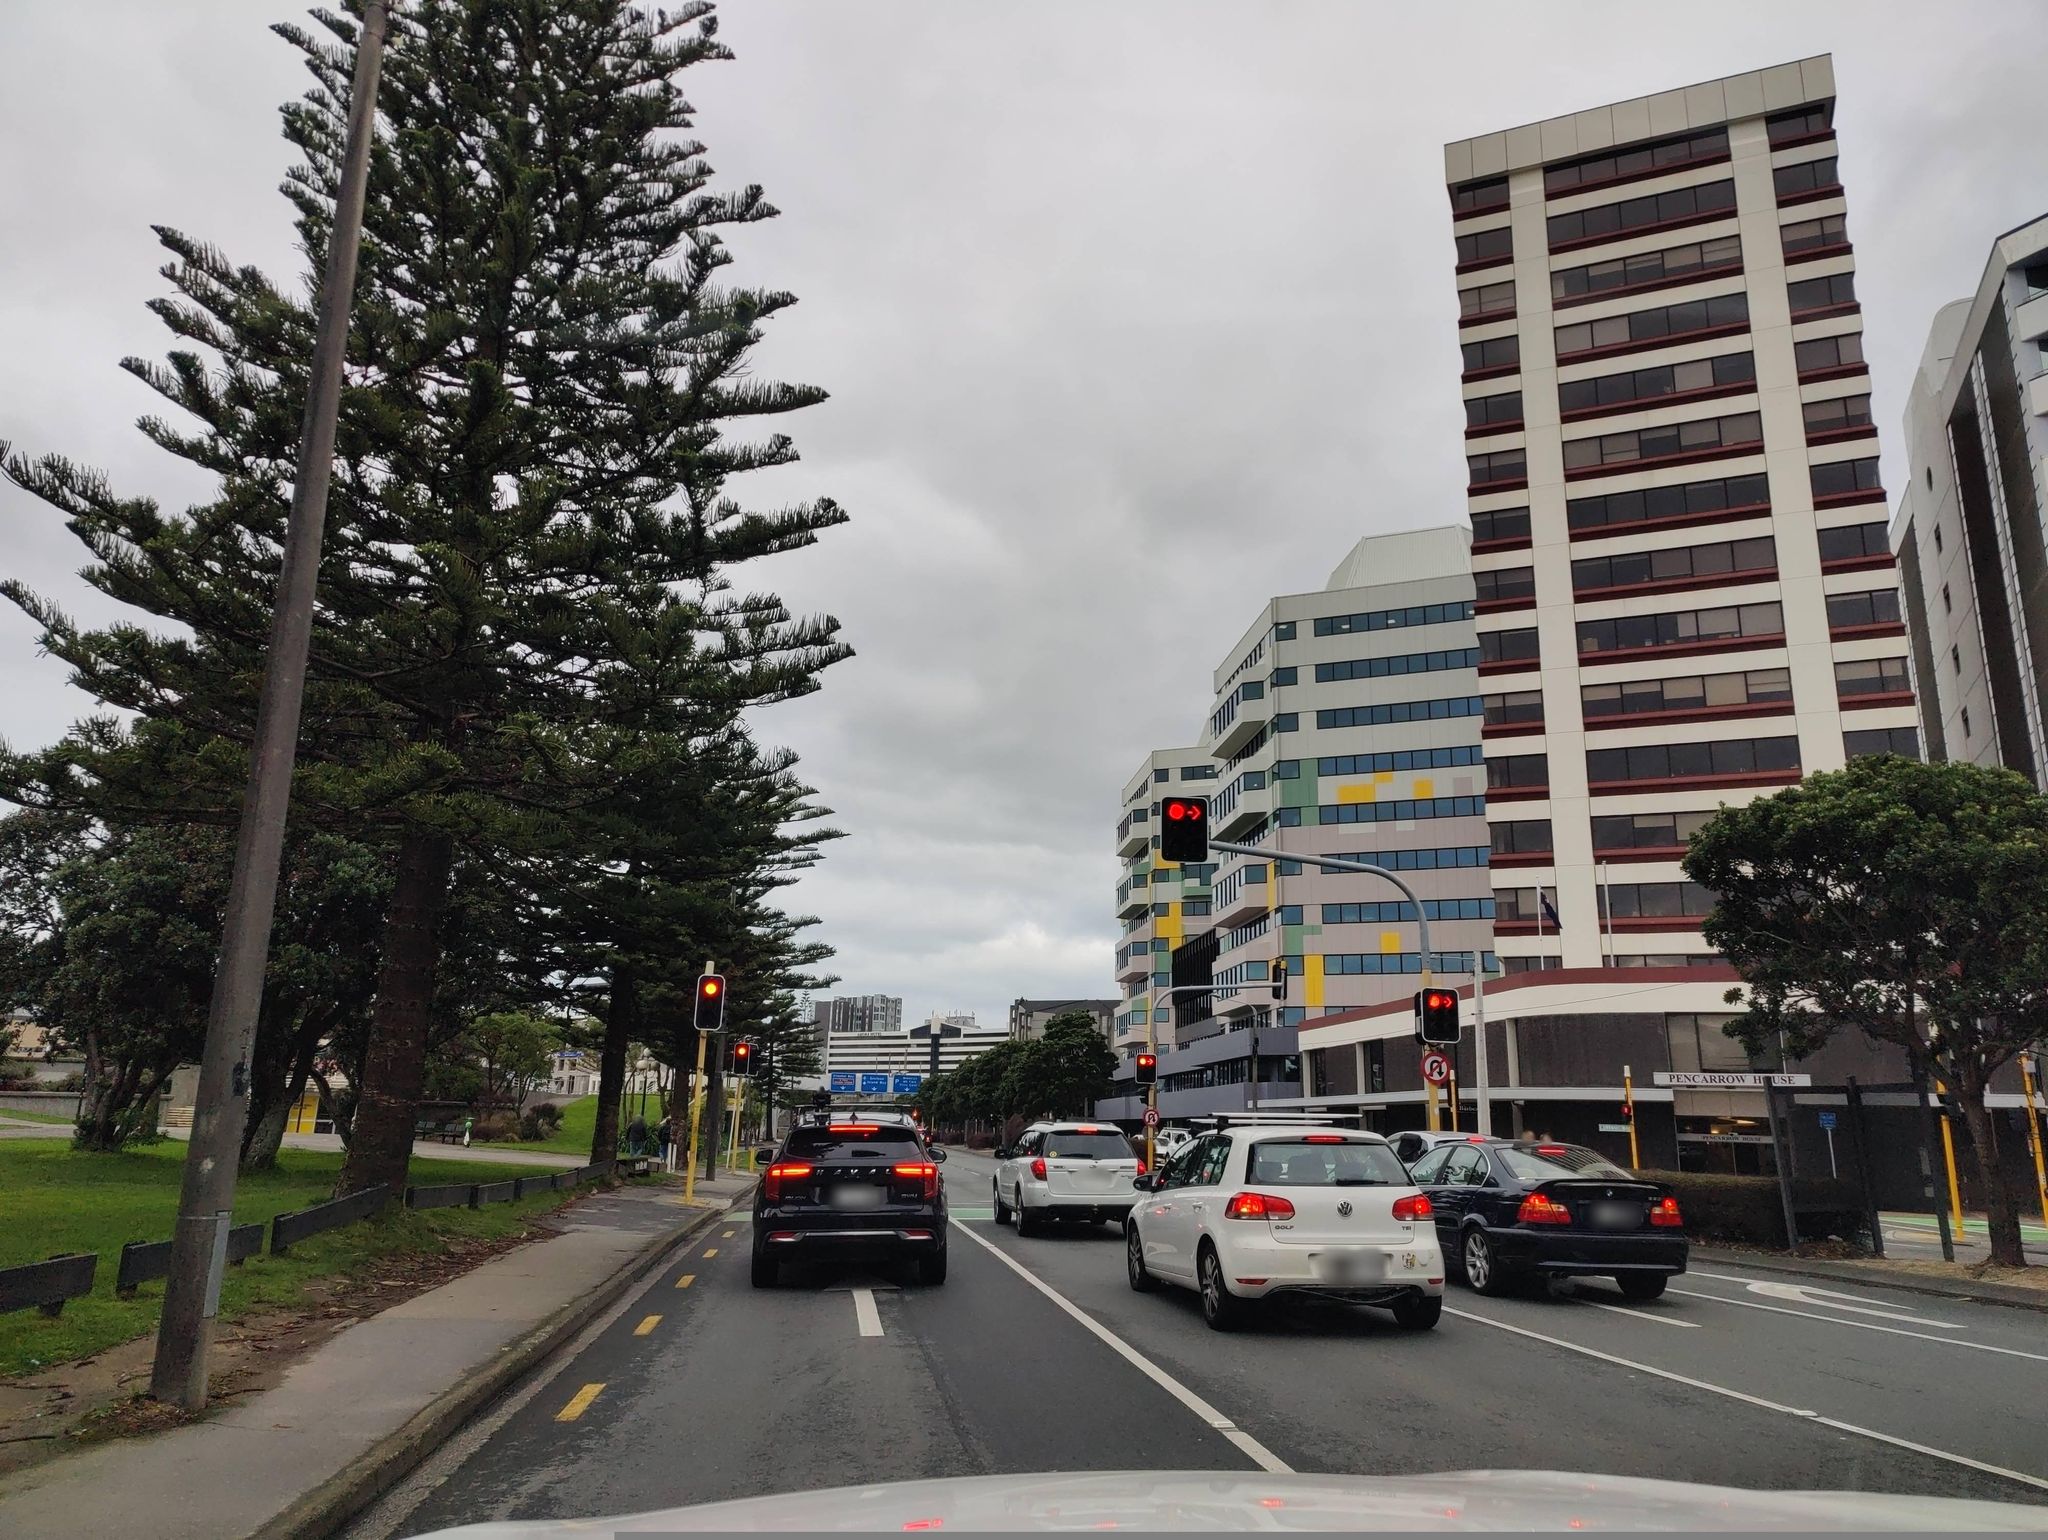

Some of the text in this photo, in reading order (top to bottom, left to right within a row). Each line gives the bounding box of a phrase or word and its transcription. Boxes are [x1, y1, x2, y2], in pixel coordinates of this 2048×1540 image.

[1669, 1074, 1796, 1085] PENCARROW HUSE
[816, 1168, 892, 1176] HAVAL
